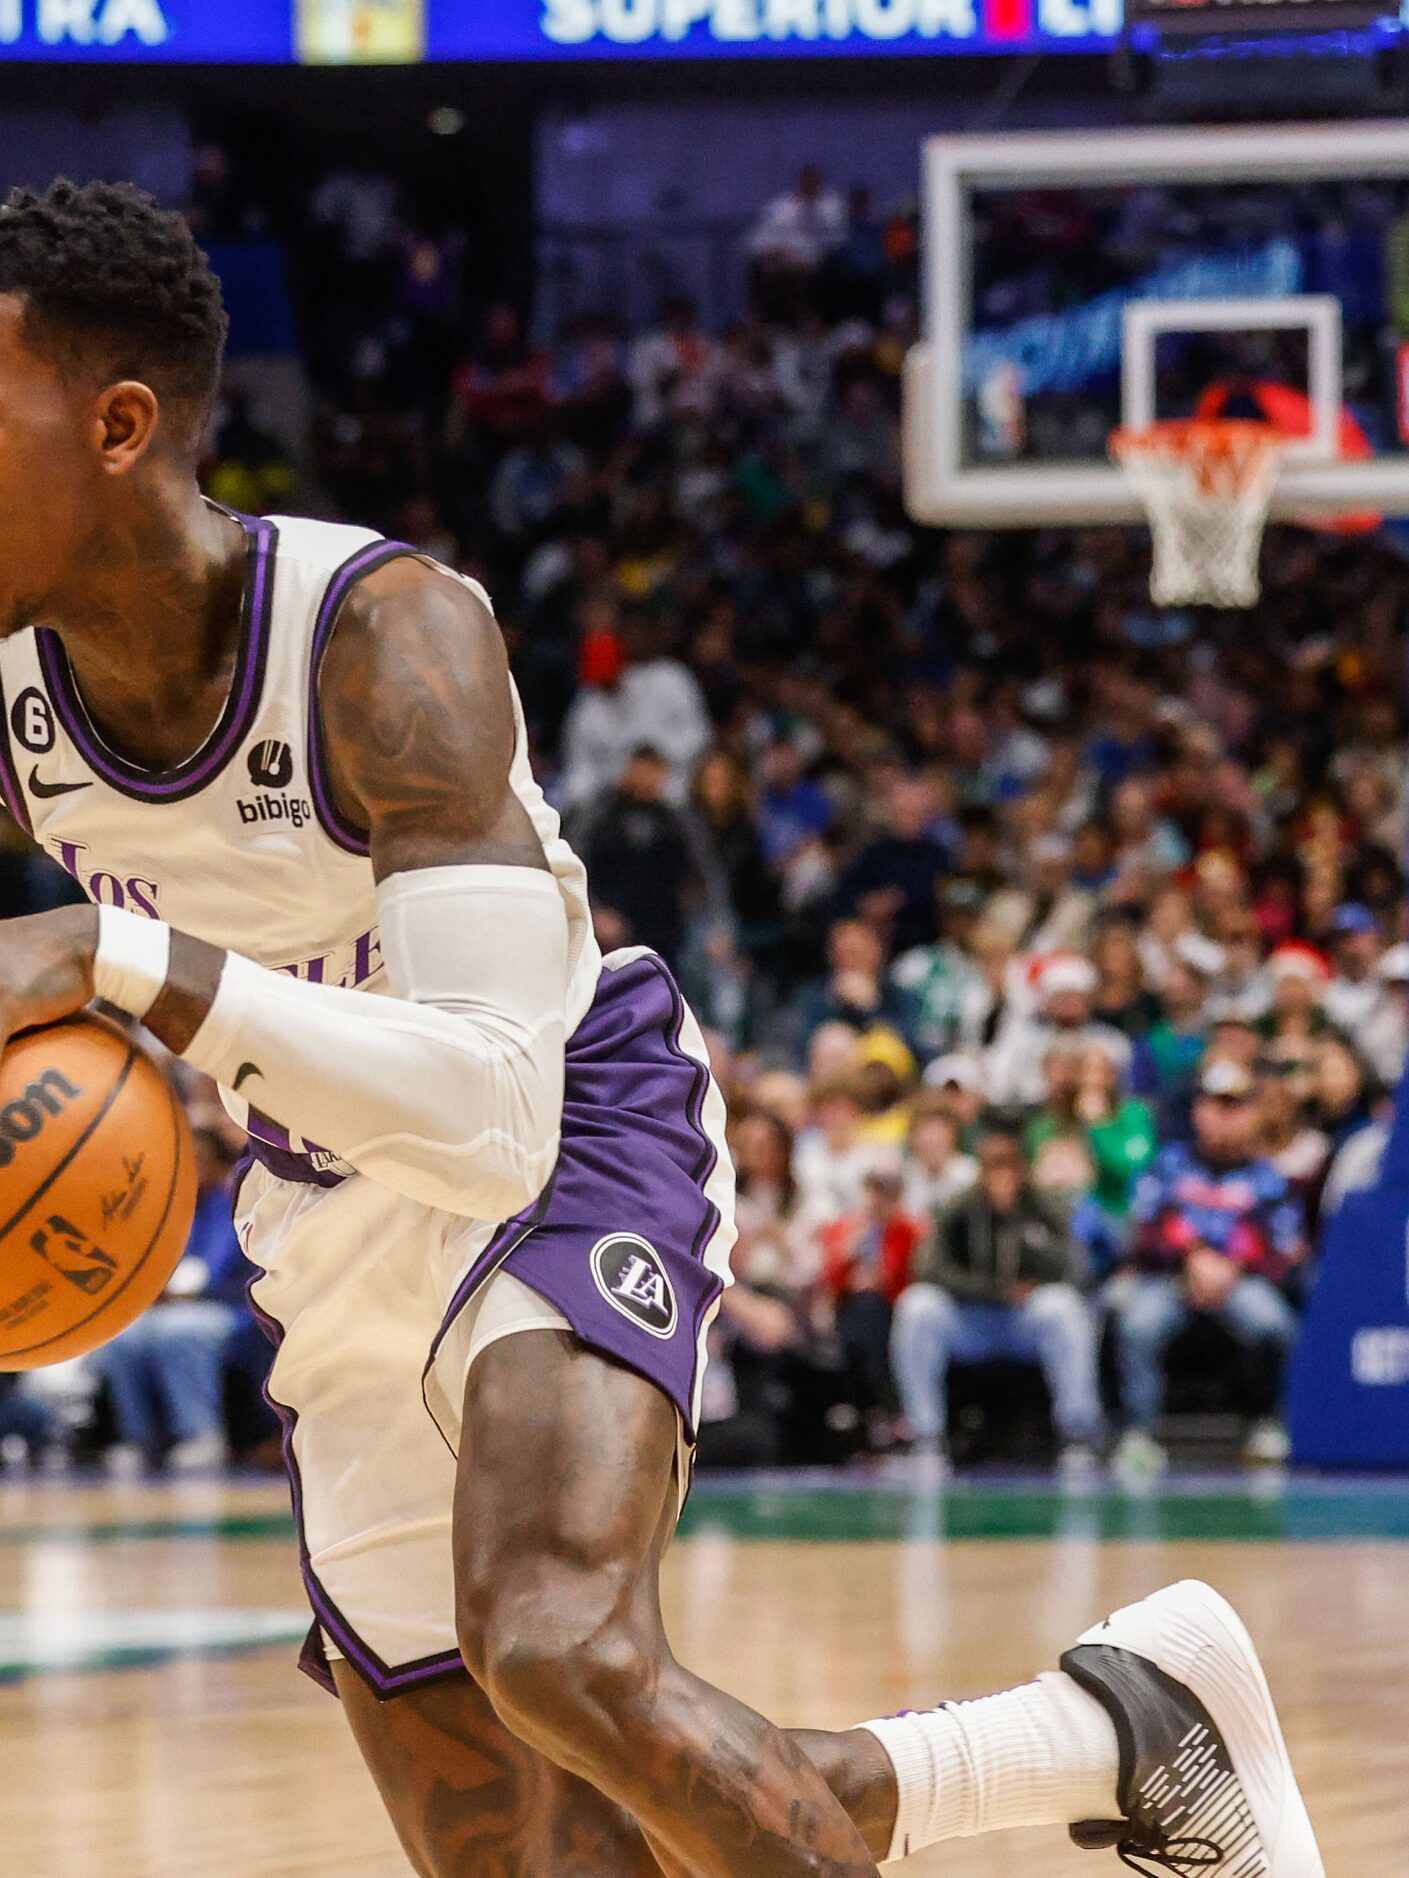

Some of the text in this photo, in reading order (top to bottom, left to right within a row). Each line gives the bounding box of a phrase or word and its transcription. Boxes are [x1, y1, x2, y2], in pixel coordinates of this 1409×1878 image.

[24, 696, 50, 746] 6
[236, 792, 311, 828] bibigo
[610, 1254, 669, 1317] LA
